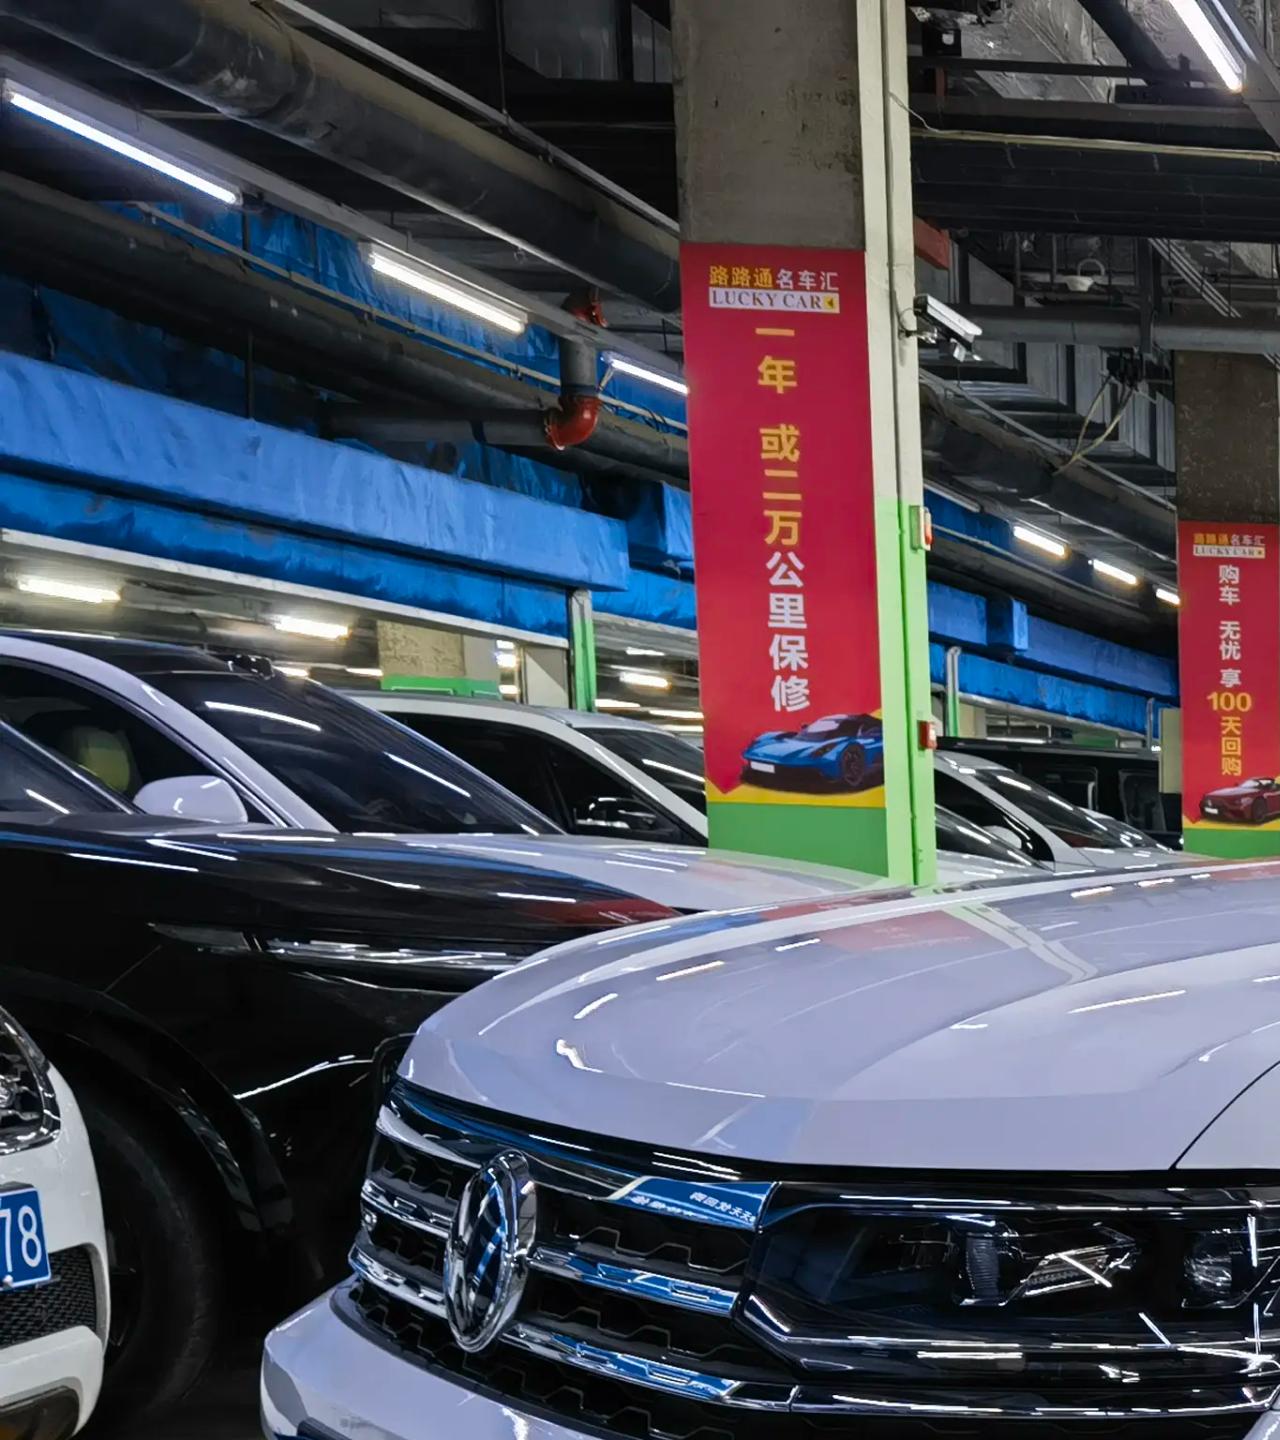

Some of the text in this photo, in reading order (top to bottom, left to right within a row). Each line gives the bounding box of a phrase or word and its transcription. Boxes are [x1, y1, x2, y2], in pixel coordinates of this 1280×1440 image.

[709, 265, 839, 291] 路路通名车汇
[712, 289, 777, 307] LUCKY
